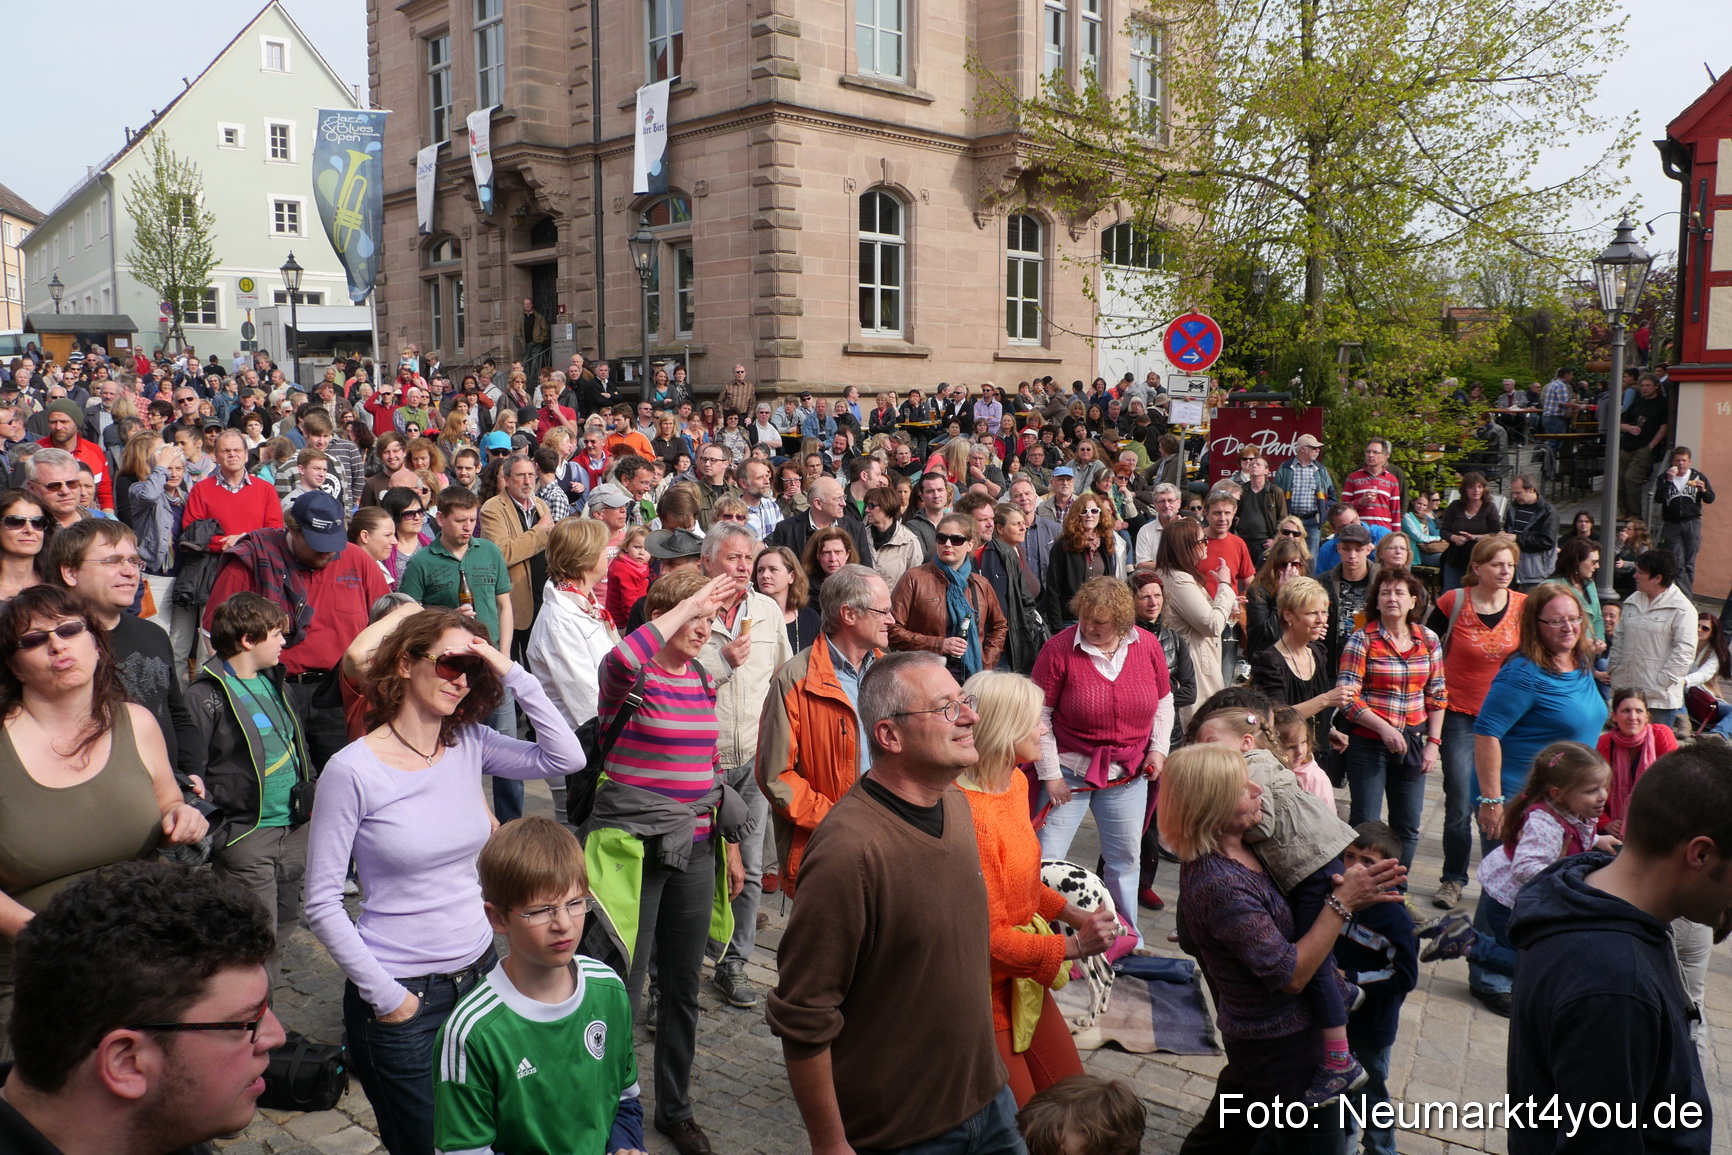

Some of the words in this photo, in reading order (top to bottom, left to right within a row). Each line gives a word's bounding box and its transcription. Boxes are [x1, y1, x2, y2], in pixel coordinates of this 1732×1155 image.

[328, 113, 363, 123] Jazz
[337, 123, 374, 133] Blues
[326, 132, 360, 144] Open
[1716, 402, 1731, 415] 14
[1211, 434, 1244, 455] De
[517, 1067, 537, 1079] adidas
